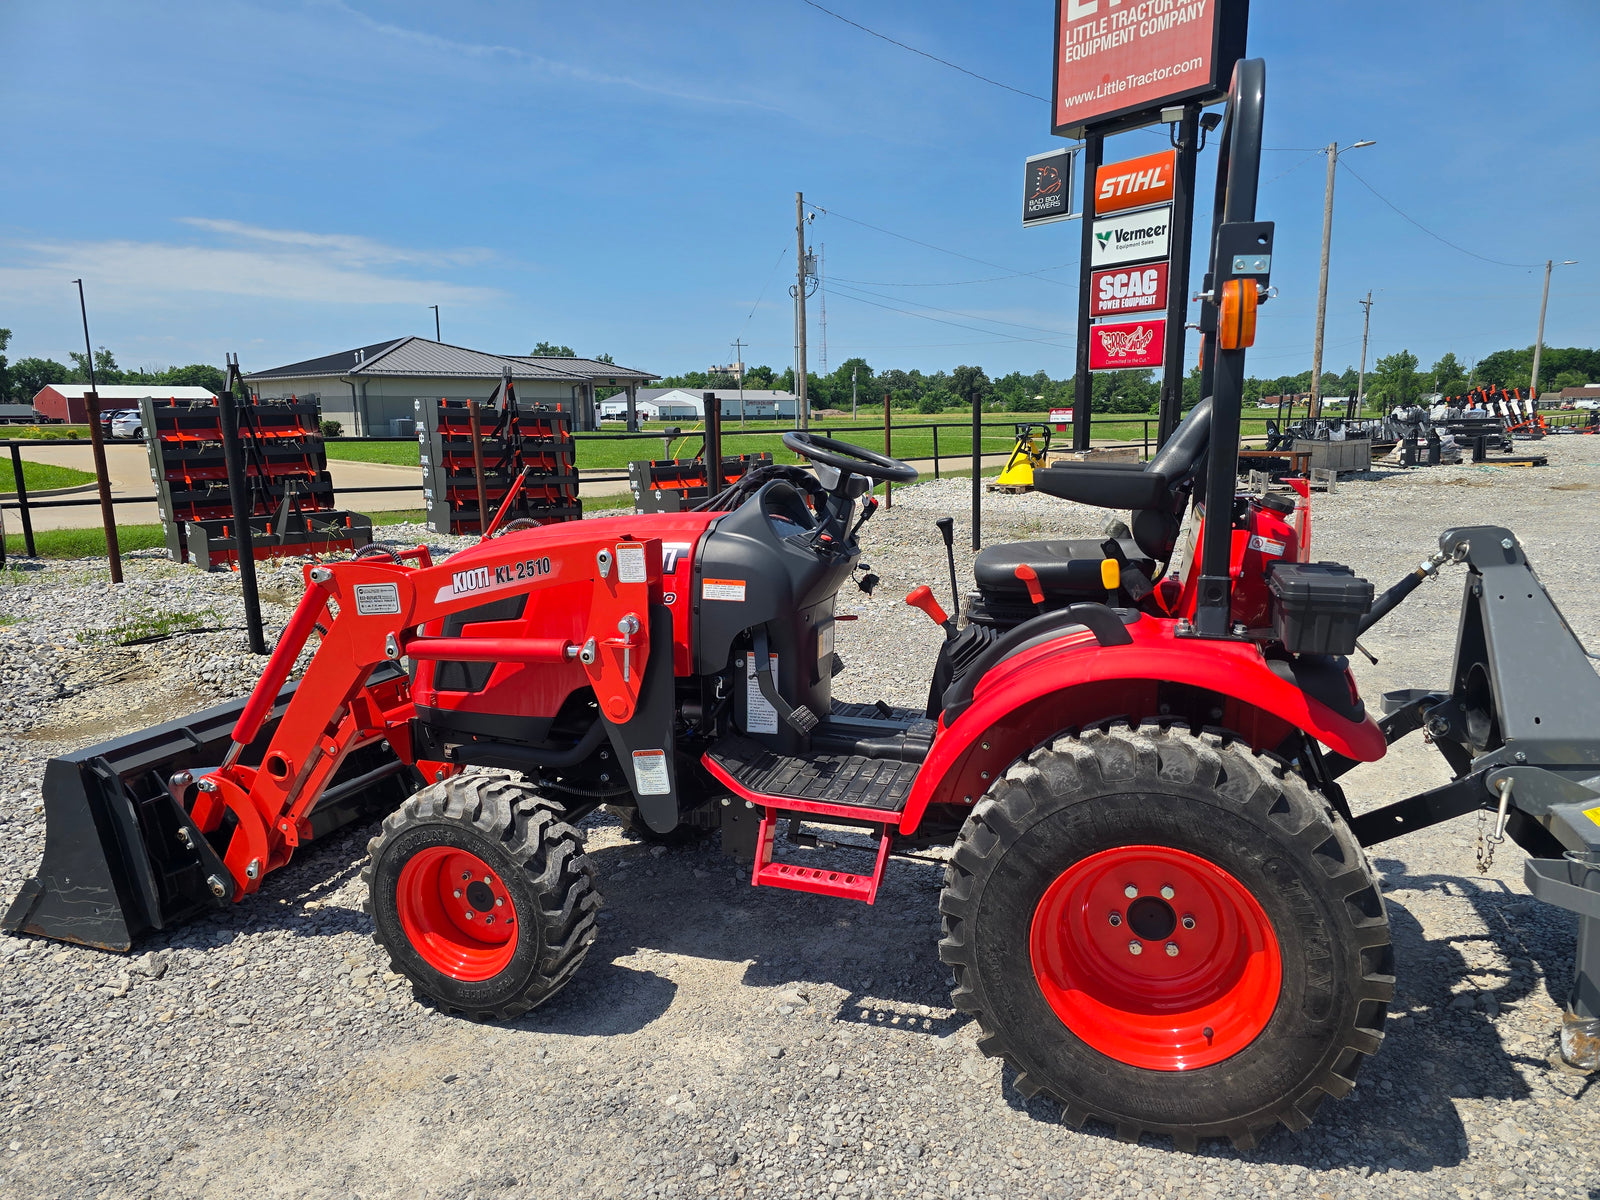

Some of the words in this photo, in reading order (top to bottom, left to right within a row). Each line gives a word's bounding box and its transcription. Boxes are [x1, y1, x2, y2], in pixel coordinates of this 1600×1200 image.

[1065, 17, 1108, 46] LITTLE
[1110, 0, 1174, 32] TRACTOR
[1065, 25, 1137, 63] EQUIPMENT
[1139, 2, 1205, 38] COMPANY
[1065, 56, 1203, 108] www.LittleTractor.com
[1098, 166, 1167, 200] STIHL
[1029, 197, 1044, 206] BAD
[1045, 194, 1060, 203] BOY
[1029, 199, 1060, 212] MOWERS
[1114, 224, 1167, 243] Vermeer
[1115, 241, 1140, 250] Equipment
[1099, 269, 1158, 300] SCAG
[1098, 298, 1120, 311] POWER
[1121, 295, 1157, 308] EQUIPMENT
[452, 566, 490, 594] KIOTI
[495, 567, 514, 584] KL
[516, 557, 550, 579] 2510
